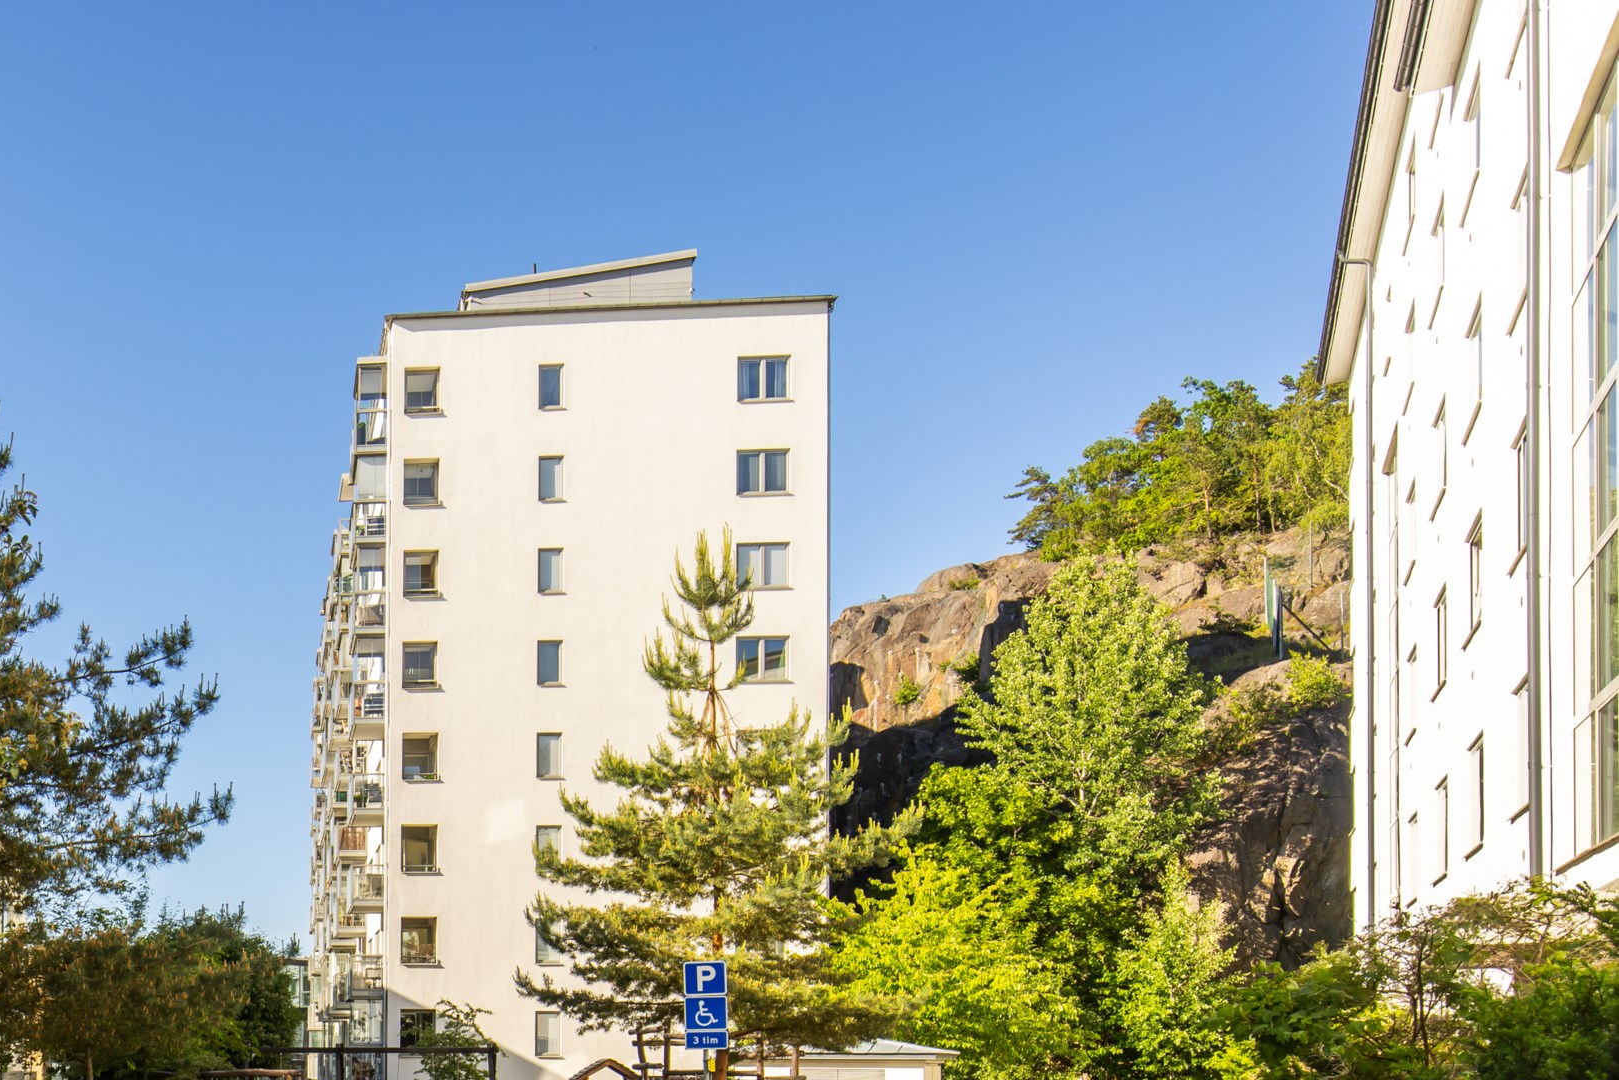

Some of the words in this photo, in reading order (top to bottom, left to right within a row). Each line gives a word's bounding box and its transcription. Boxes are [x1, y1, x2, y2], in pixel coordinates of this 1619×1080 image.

[696, 965, 717, 992] P
[692, 1036, 700, 1045] 3
[702, 1036, 719, 1045] tim
